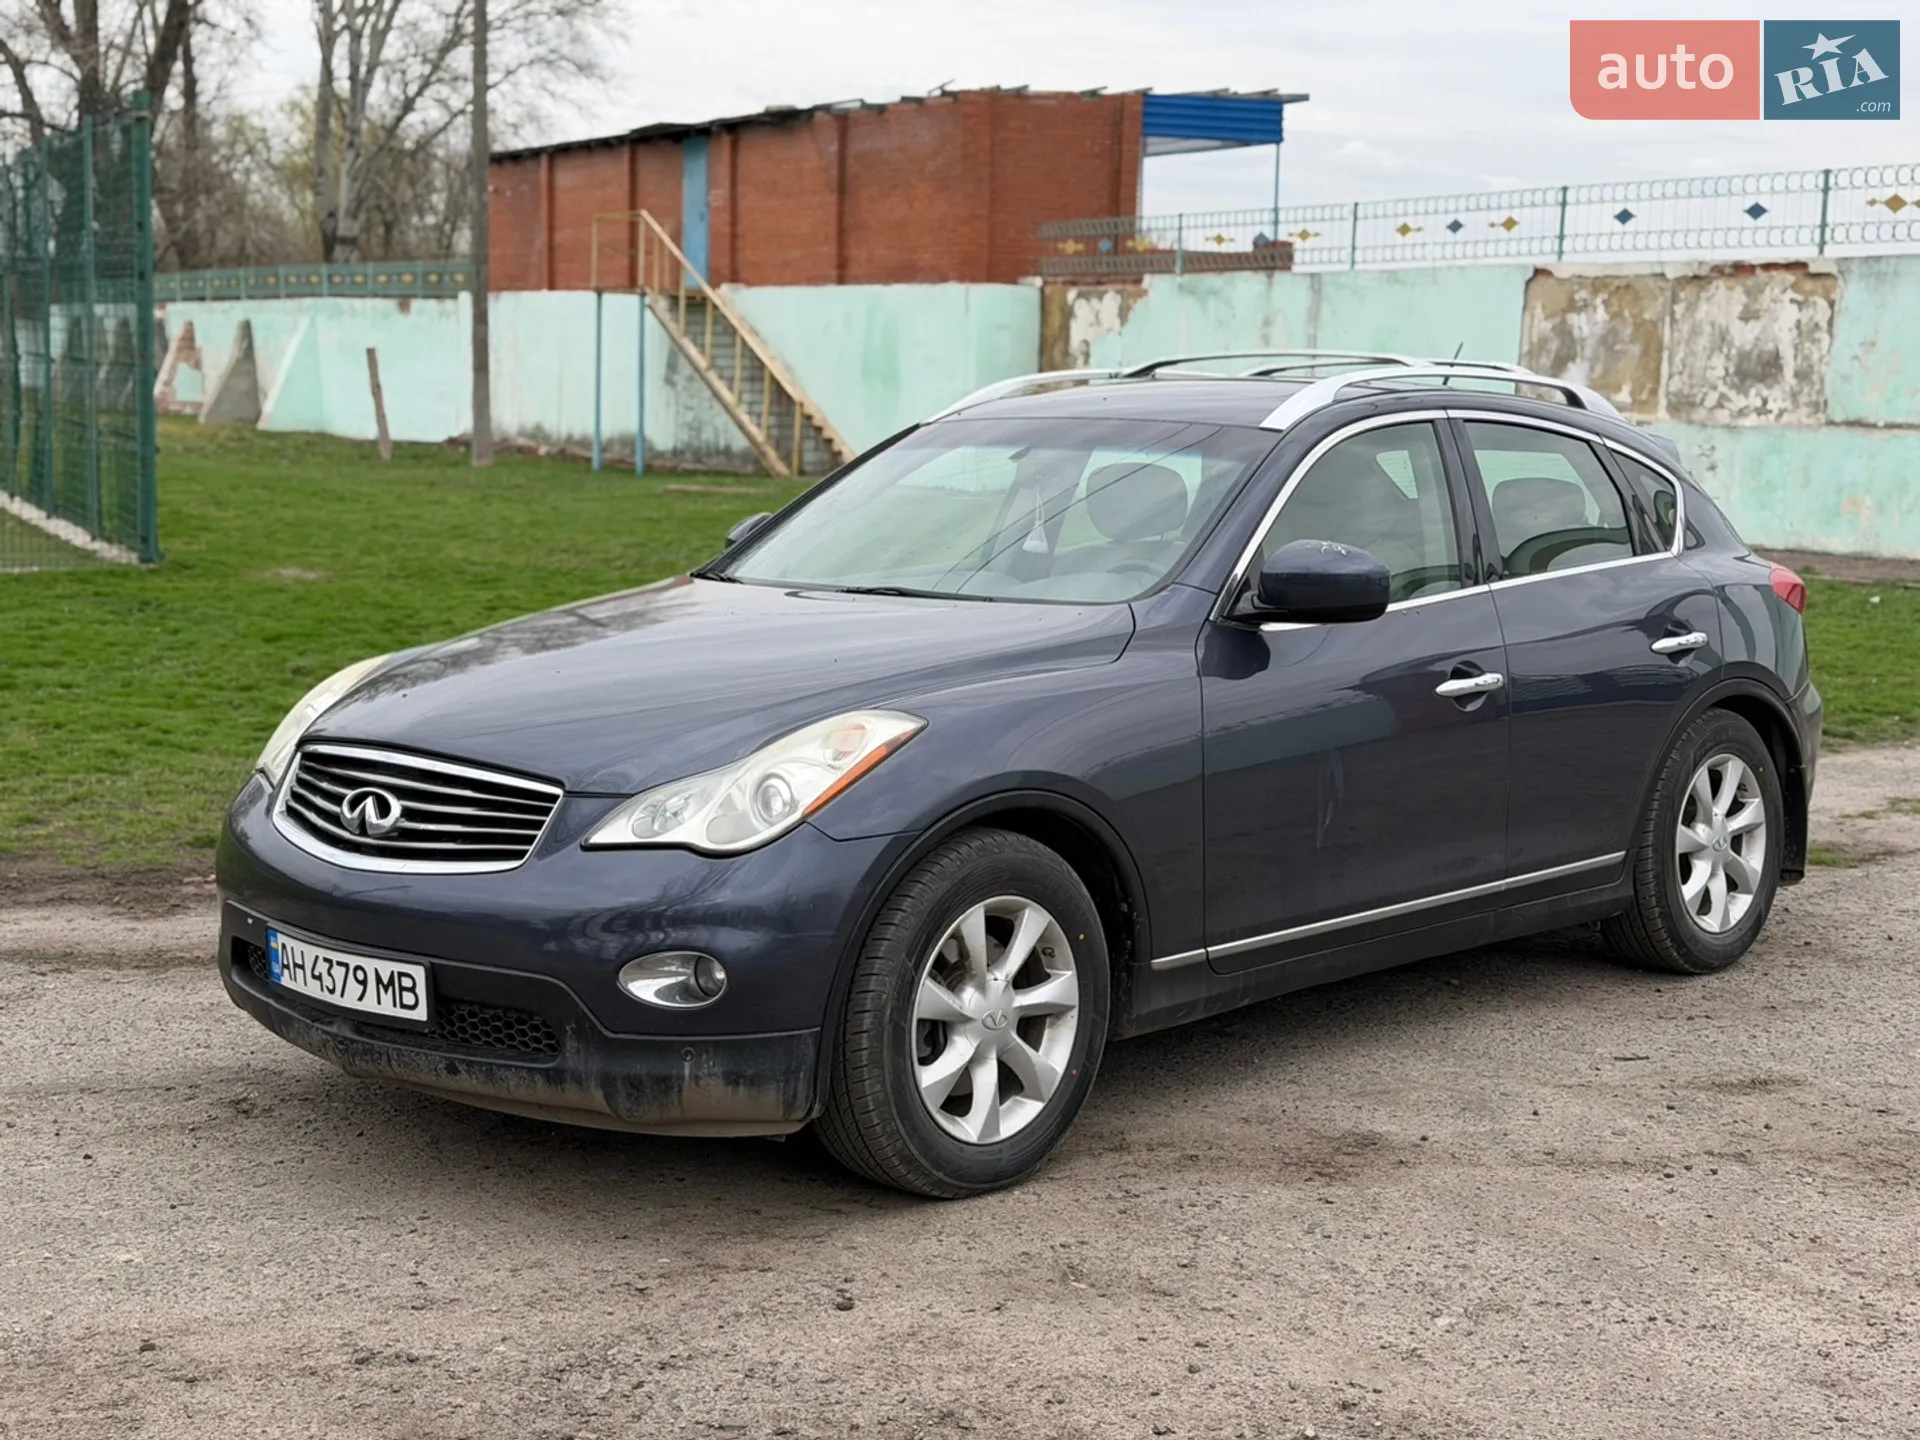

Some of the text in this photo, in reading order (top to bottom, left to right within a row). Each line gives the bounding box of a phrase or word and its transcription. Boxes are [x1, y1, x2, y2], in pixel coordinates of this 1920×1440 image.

[281, 942, 420, 1011] AH 4379 MB
